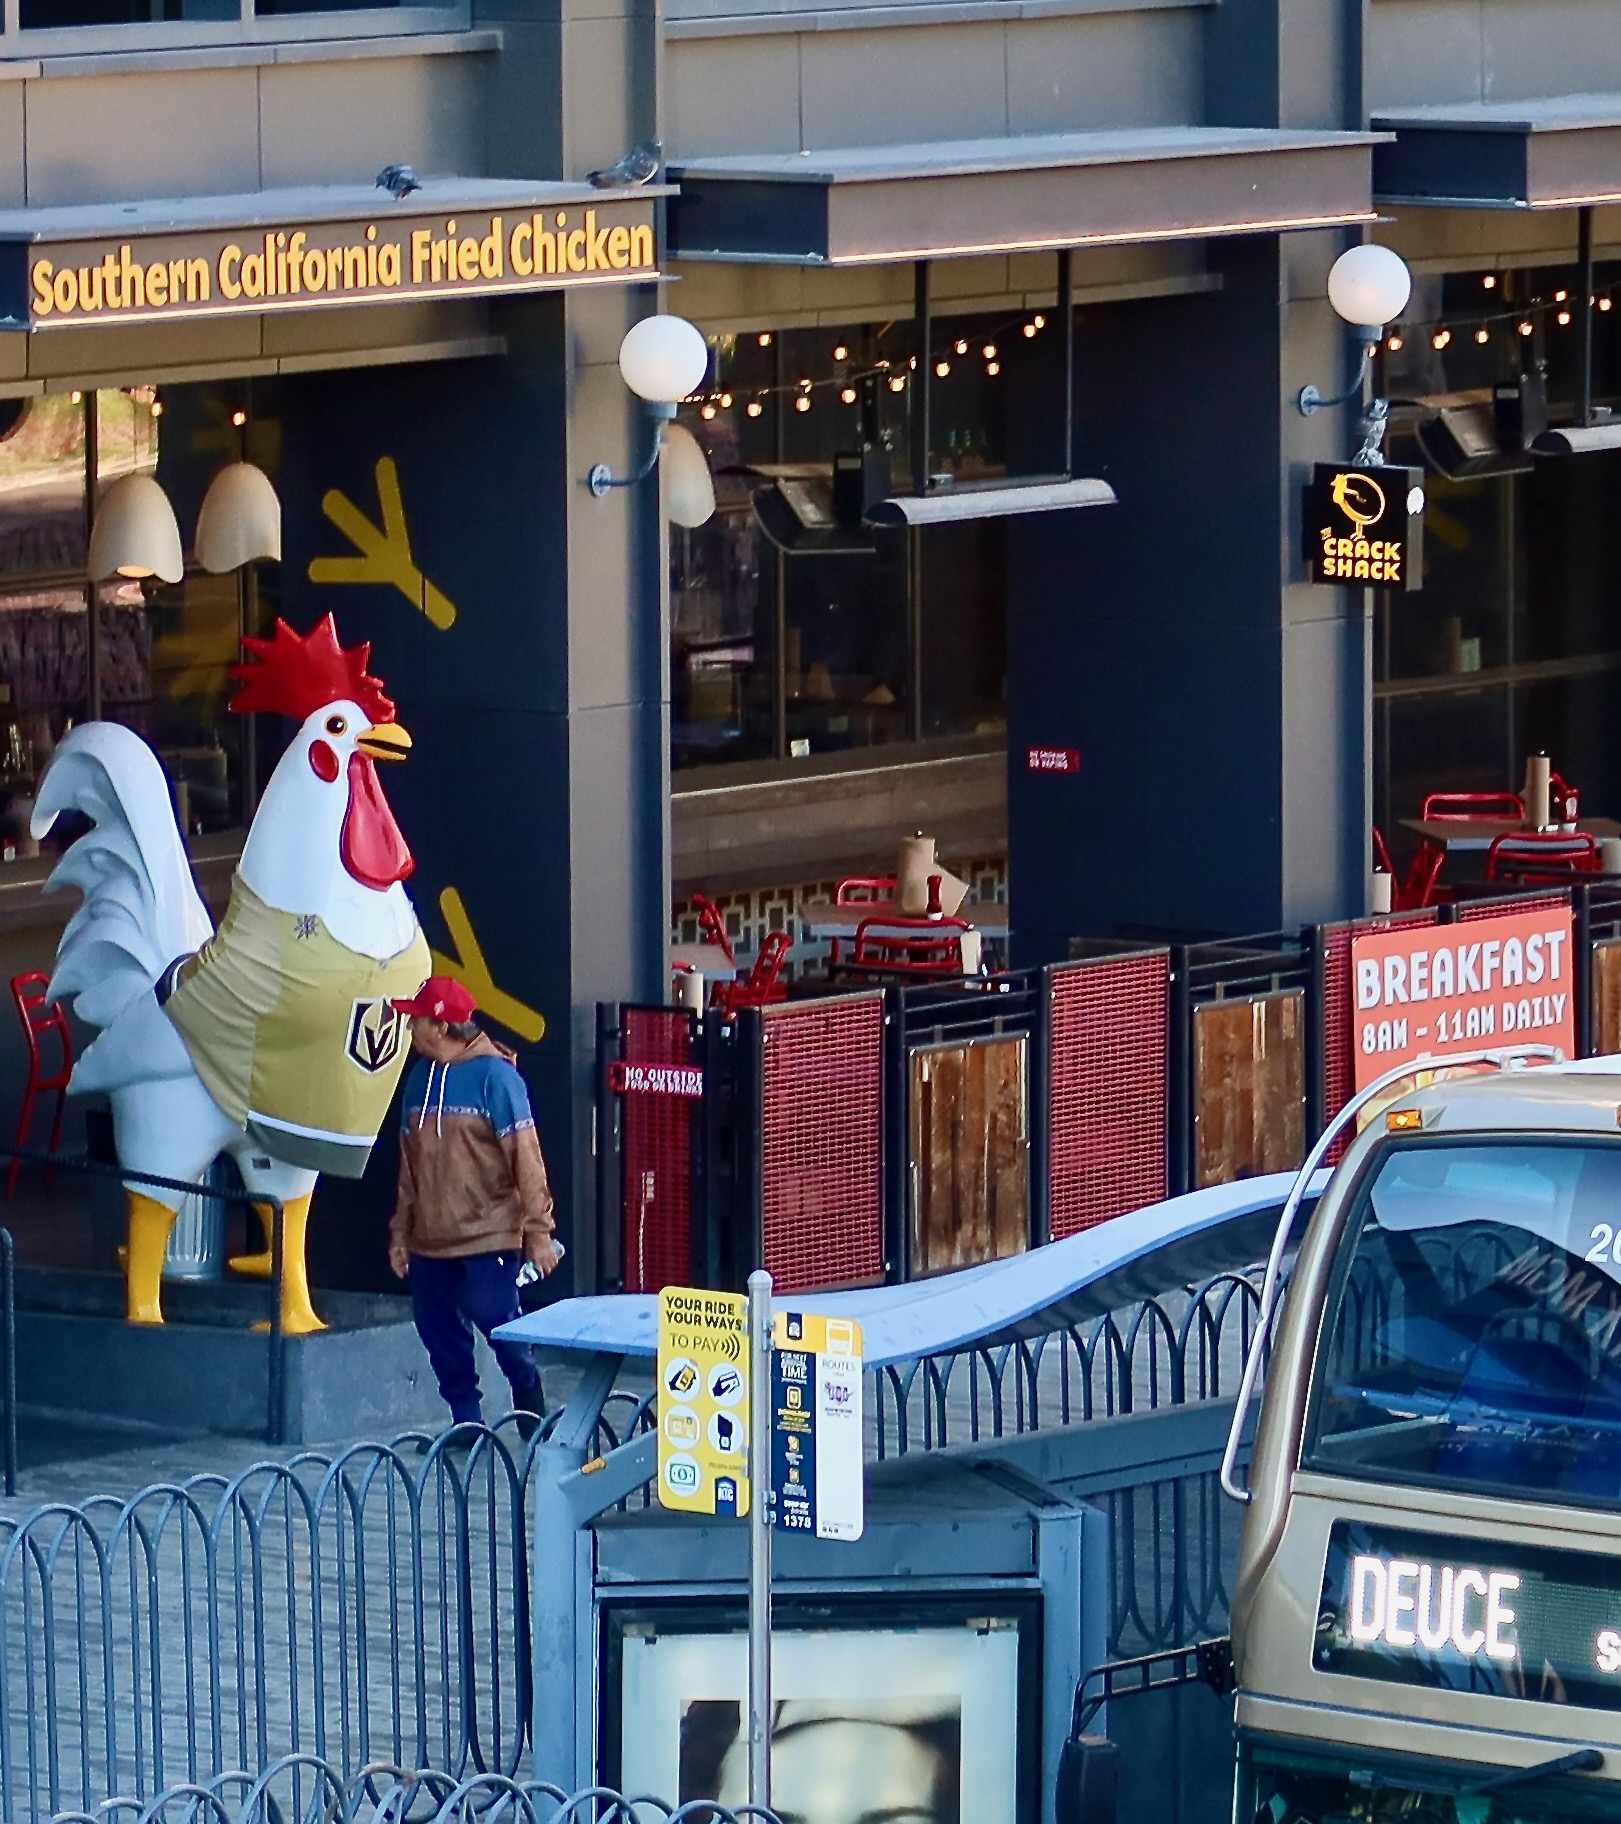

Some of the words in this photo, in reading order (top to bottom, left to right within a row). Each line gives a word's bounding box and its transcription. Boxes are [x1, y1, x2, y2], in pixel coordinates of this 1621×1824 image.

[32, 245, 210, 316] Southern
[218, 232, 401, 301] California
[411, 217, 503, 284] Fried
[510, 210, 653, 276] Chicken
[1323, 537, 1402, 560] CRACK
[1323, 557, 1401, 580] SHACK
[1357, 930, 1566, 1010] BREAKFAST
[1362, 1018, 1409, 1055] 8AM
[1436, 1004, 1496, 1045] 11AM
[1502, 993, 1567, 1034] DAILY
[666, 1296, 702, 1312] YOUR
[704, 1301, 735, 1316] RIDE
[666, 1310, 702, 1326] YOUR
[704, 1314, 743, 1331] WAYS
[669, 1332, 689, 1349] TO
[693, 1335, 720, 1352] PAY
[781, 1365, 808, 1379] TIME
[1351, 1555, 1522, 1661] DEUCE
